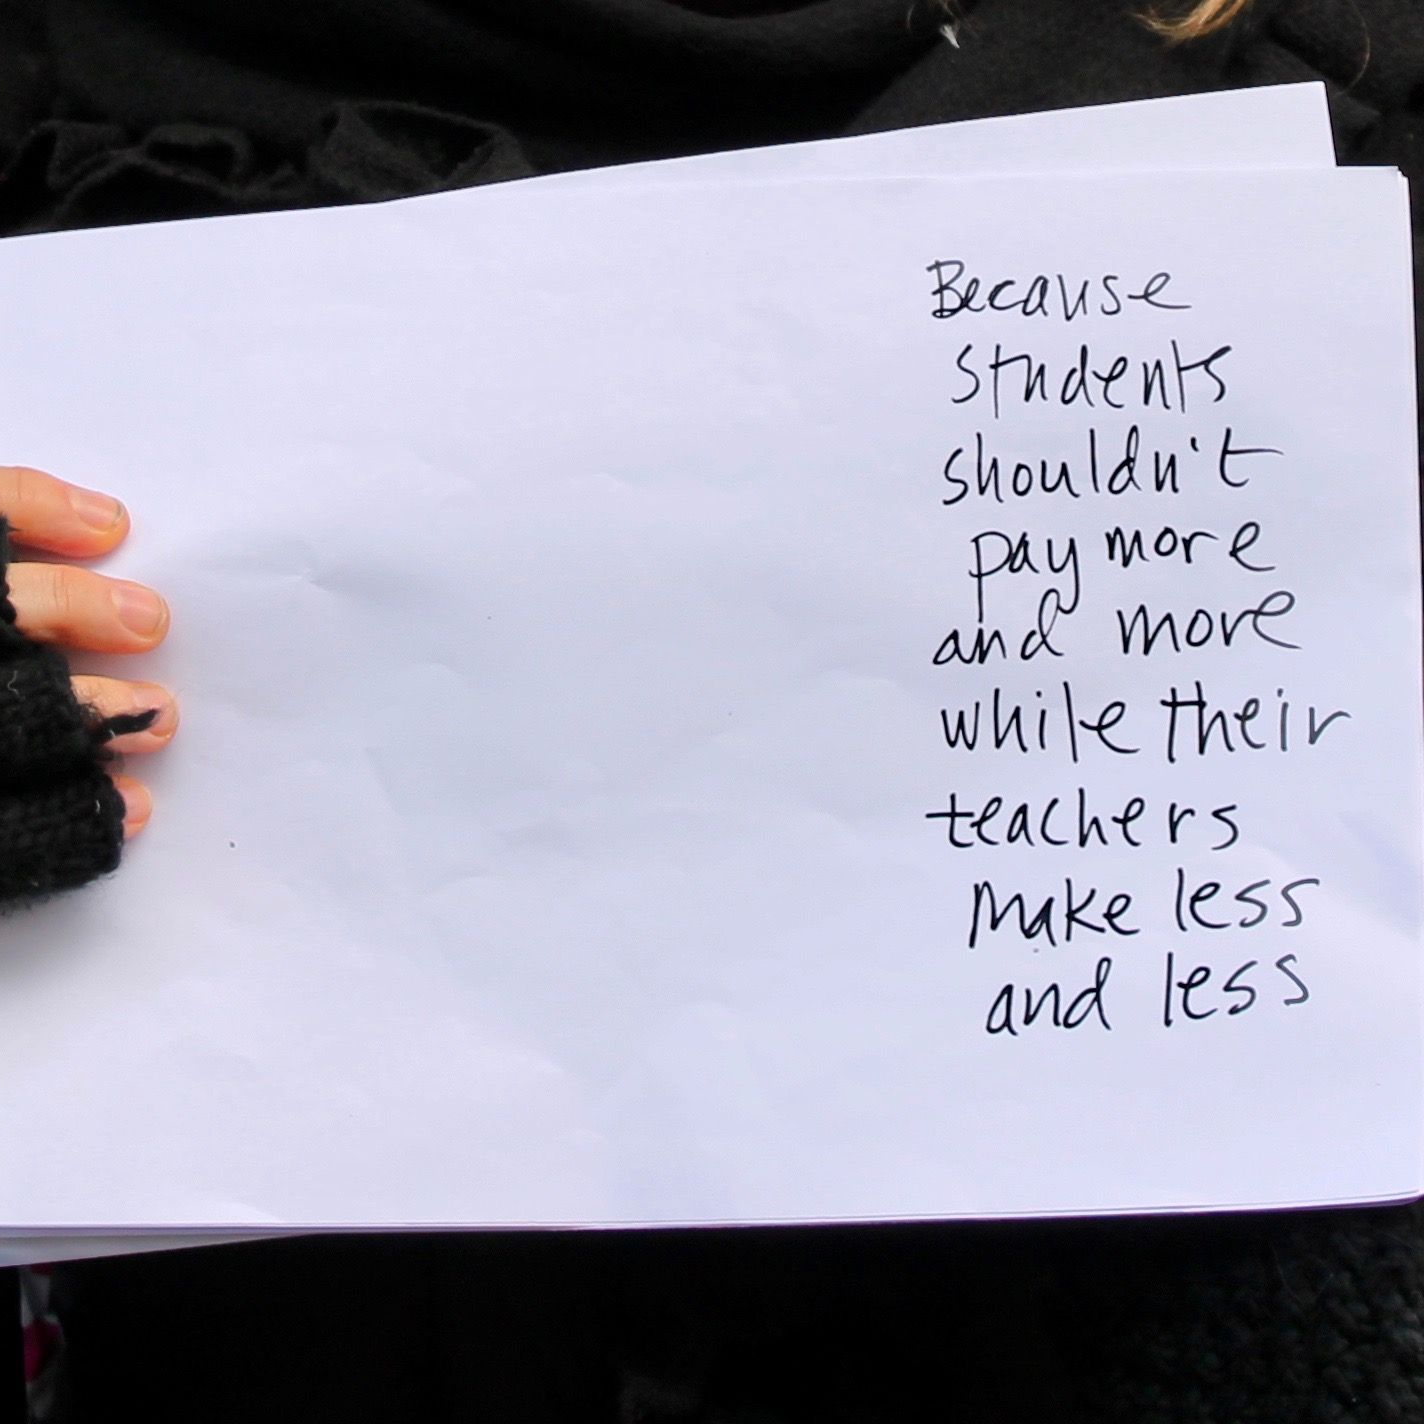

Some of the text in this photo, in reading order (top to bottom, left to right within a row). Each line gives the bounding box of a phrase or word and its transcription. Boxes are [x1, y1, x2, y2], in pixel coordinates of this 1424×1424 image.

[926, 260, 1192, 322] Because
[951, 339, 1233, 419] students
[942, 424, 1283, 506] shouldn't
[968, 521, 1276, 623] pay more
[932, 588, 1302, 665] and more
[941, 680, 1351, 764] while their
[925, 787, 1239, 850] teachers
[1175, 867, 1320, 932] less
[985, 952, 1309, 1036] and less
